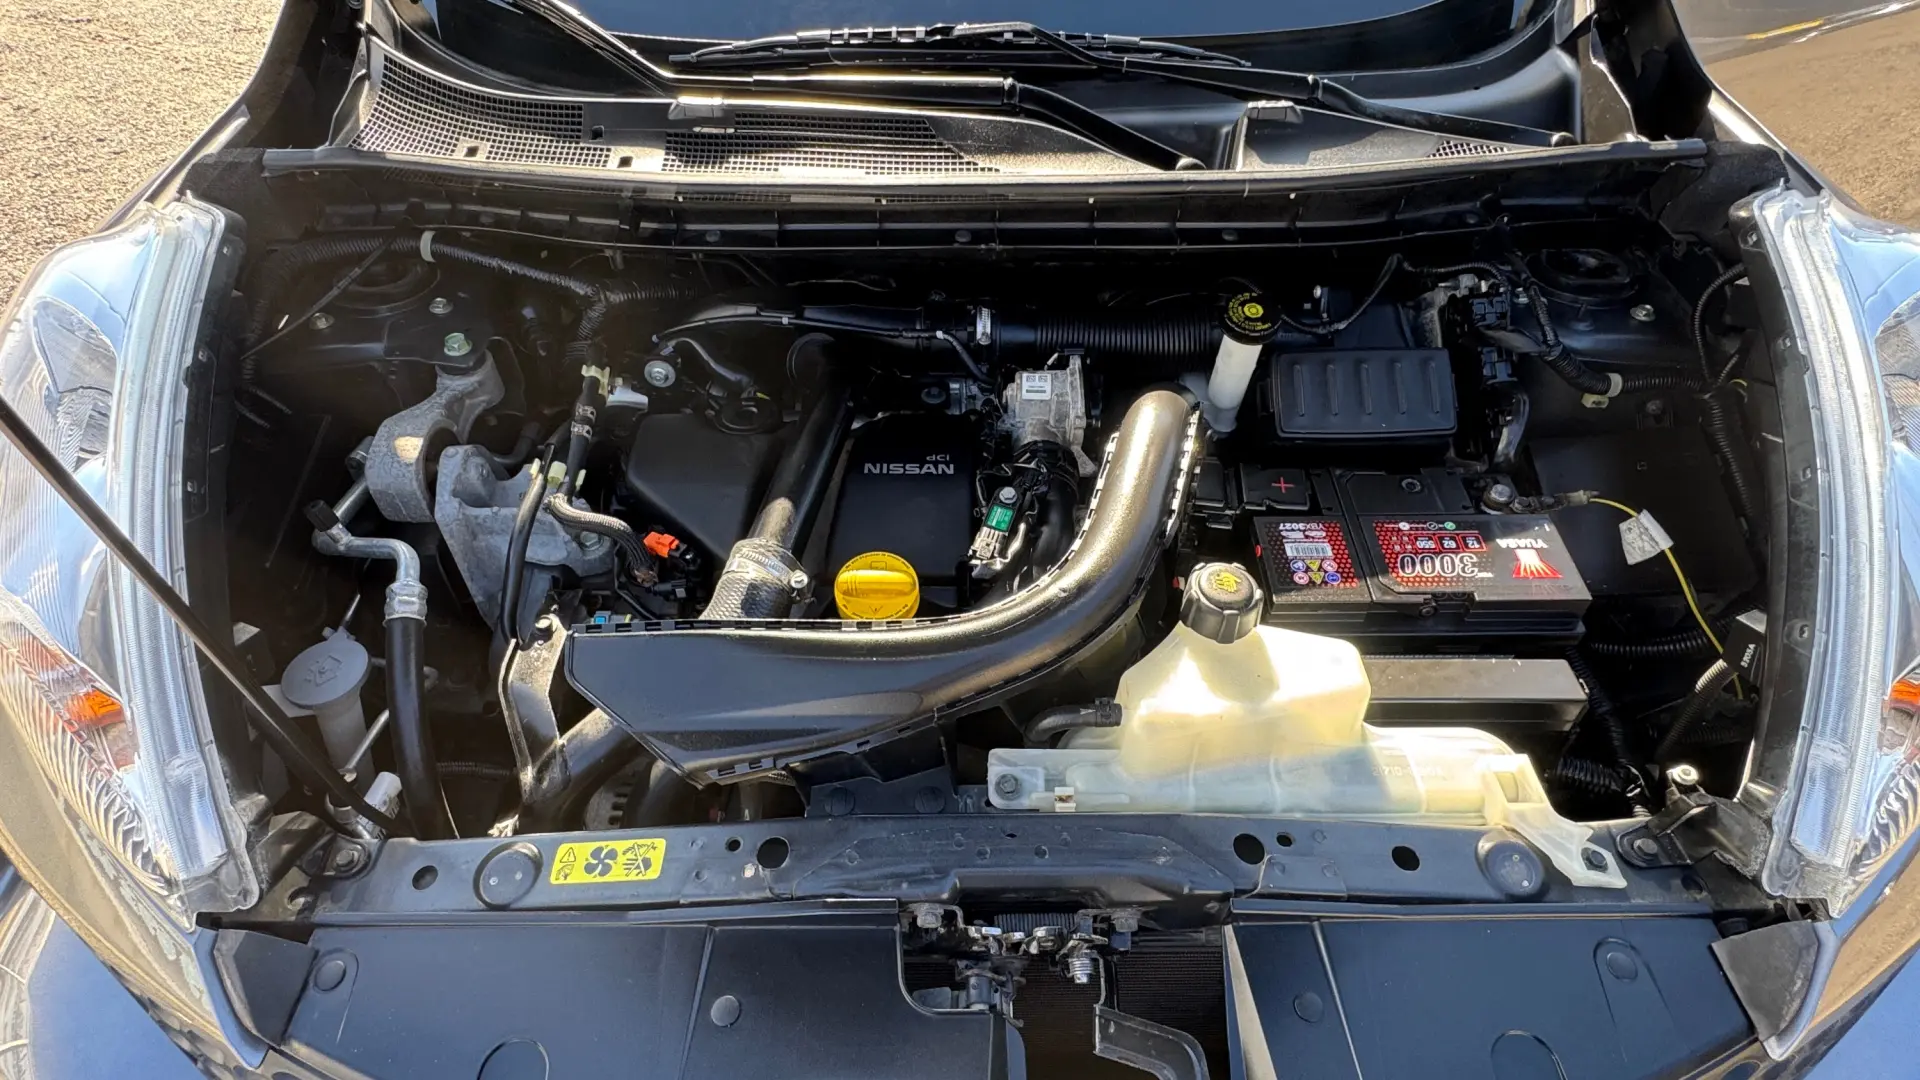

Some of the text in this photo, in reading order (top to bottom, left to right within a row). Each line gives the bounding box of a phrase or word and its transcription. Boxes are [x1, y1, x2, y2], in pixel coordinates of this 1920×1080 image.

[863, 463, 955, 475] NISSAN
[1279, 522, 1328, 531] YBX3027
[1416, 540, 1436, 549] 550
[1442, 540, 1457, 549] 62
[1466, 540, 1481, 549] 12
[1495, 538, 1549, 549] YUASA
[1398, 553, 1479, 577] 3000
